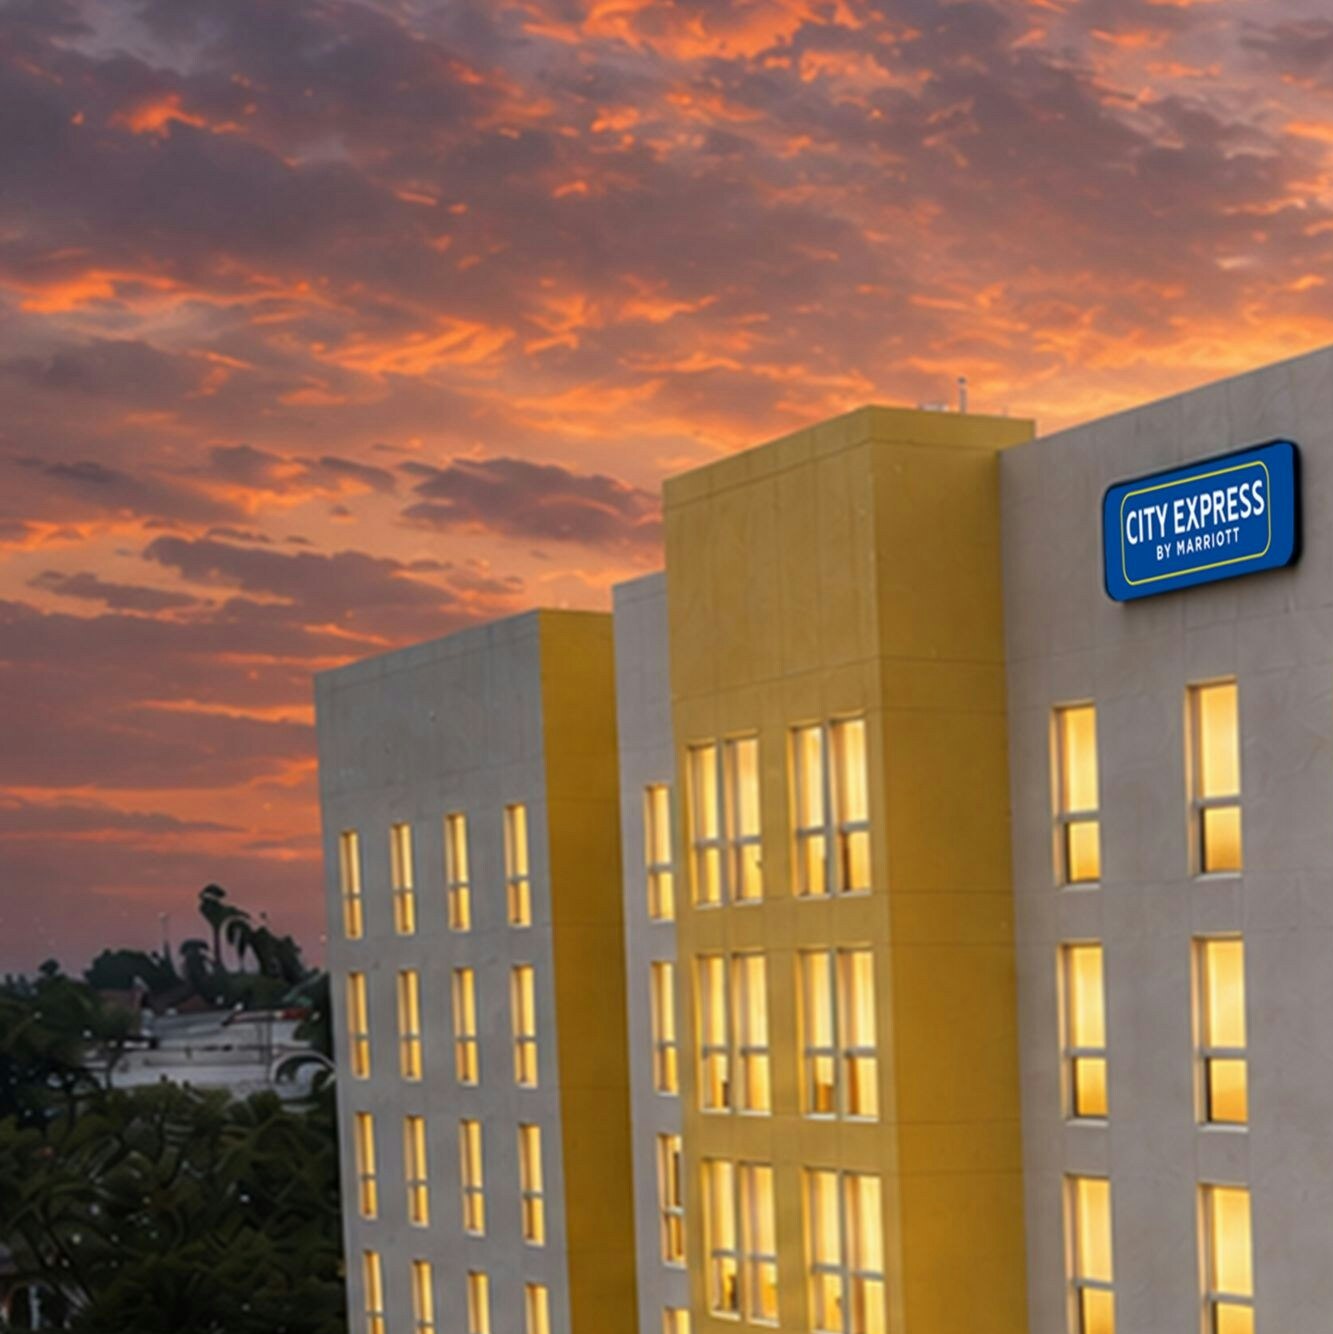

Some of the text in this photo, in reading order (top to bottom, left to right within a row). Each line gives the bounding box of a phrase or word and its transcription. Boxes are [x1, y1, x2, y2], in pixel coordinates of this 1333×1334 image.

[1126, 480, 1265, 545] CITY EXPRESS
[1156, 527, 1239, 560] BY MARRIOTT
